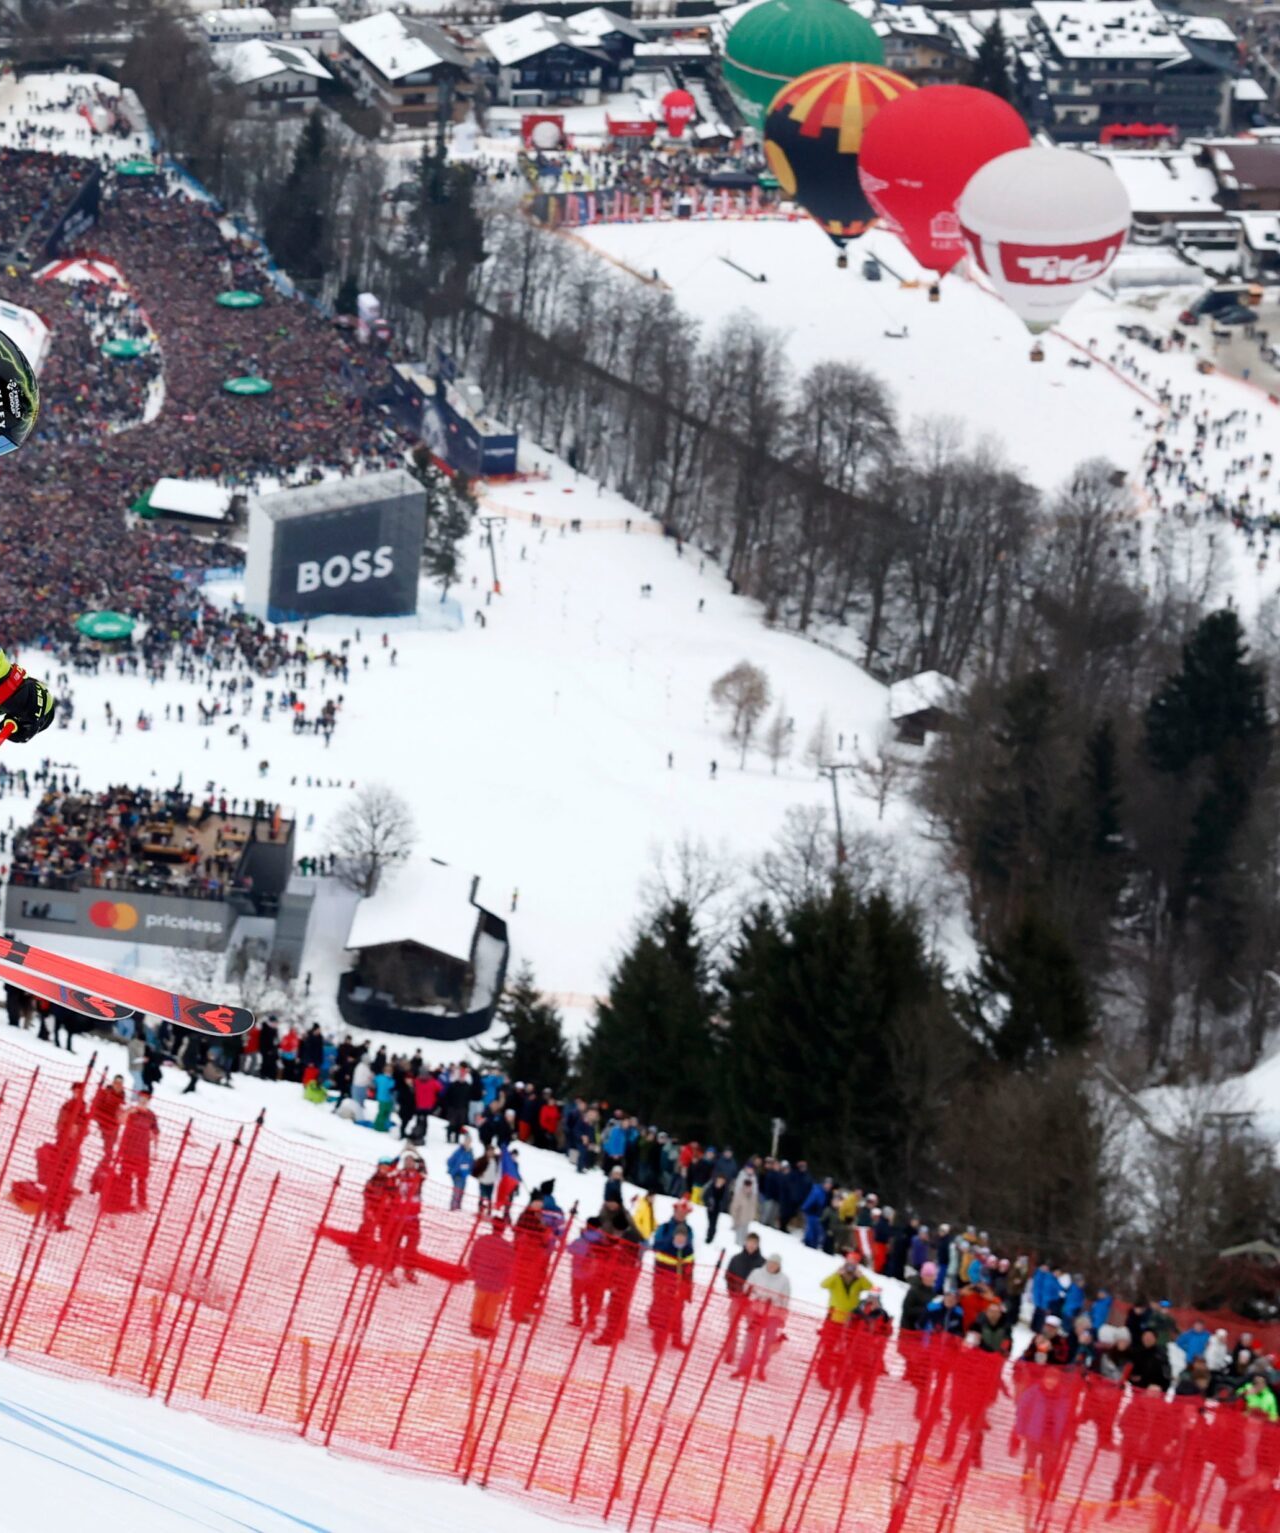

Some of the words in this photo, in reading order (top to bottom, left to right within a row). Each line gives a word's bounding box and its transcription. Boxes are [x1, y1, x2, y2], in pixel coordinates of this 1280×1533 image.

[1017, 246, 1118, 281] Tirol
[297, 546, 394, 594] BOSS
[145, 913, 223, 934] priceless
